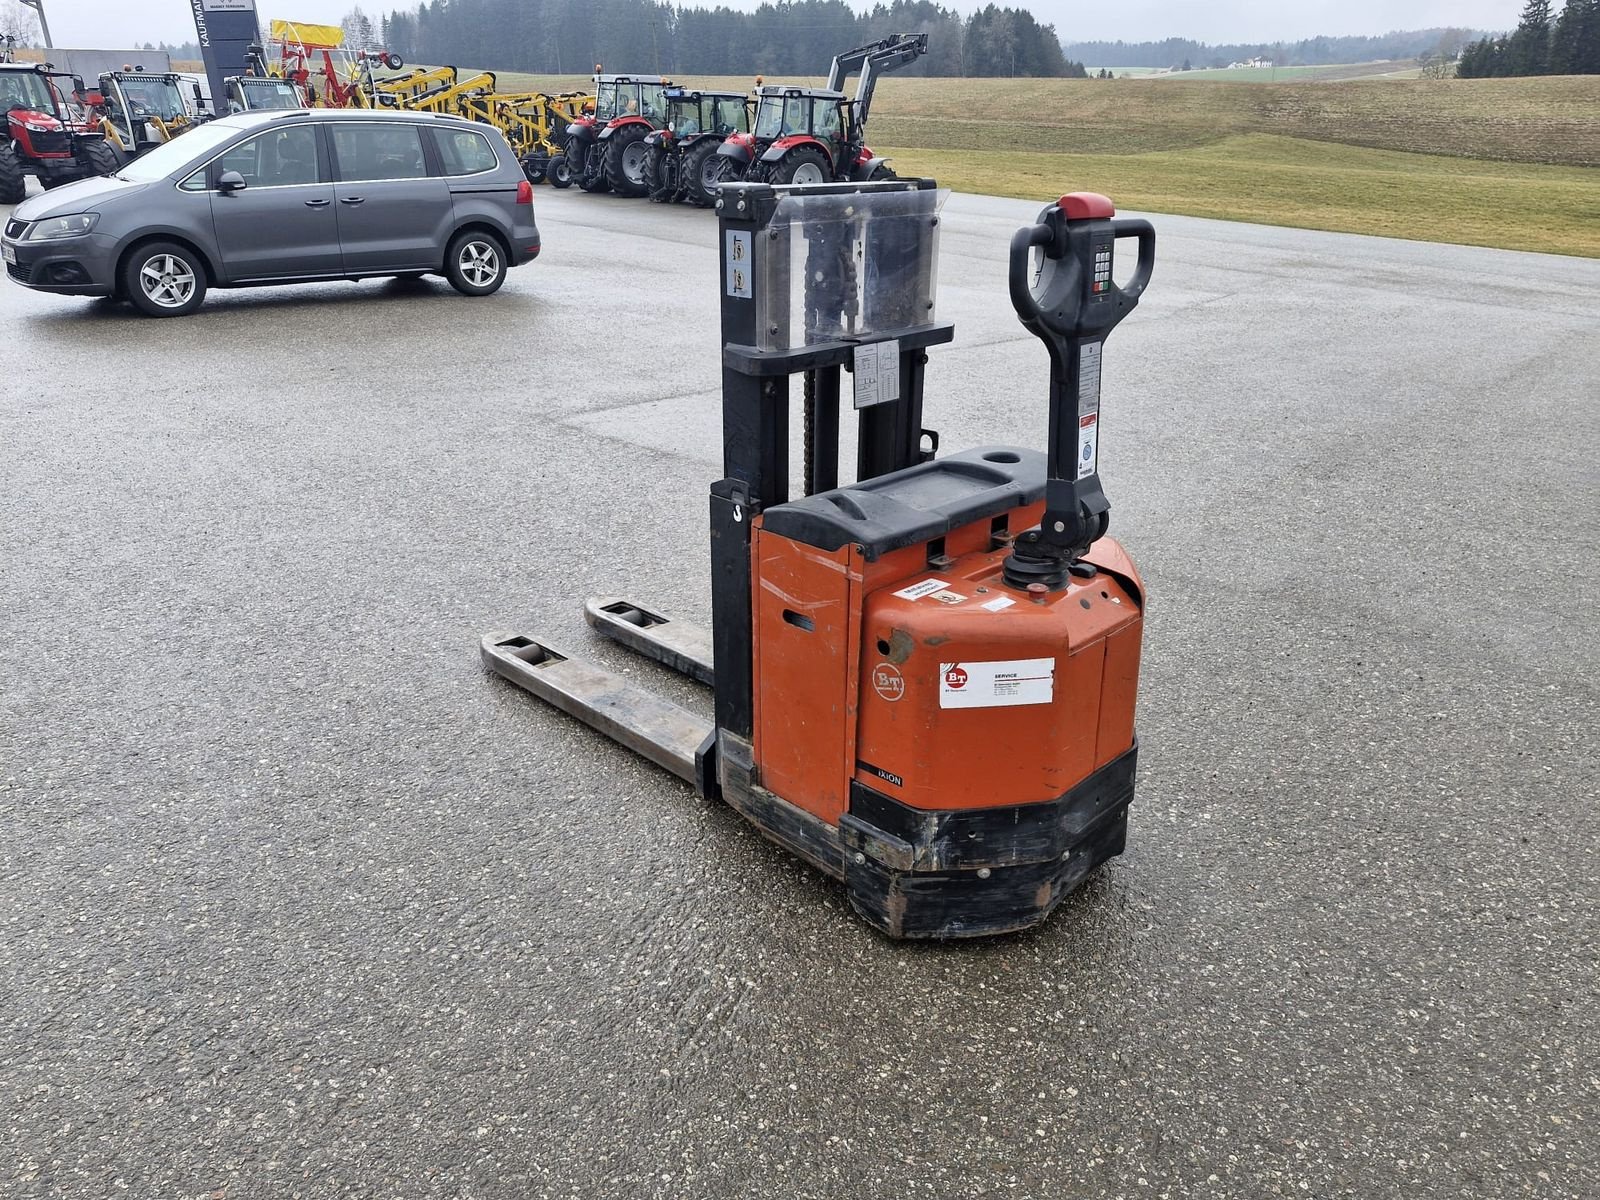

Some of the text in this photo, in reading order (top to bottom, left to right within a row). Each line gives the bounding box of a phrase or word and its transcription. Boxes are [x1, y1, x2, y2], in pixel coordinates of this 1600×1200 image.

[877, 672, 901, 691] BT
[948, 672, 967, 684] BT
[878, 769, 901, 785] IXION
